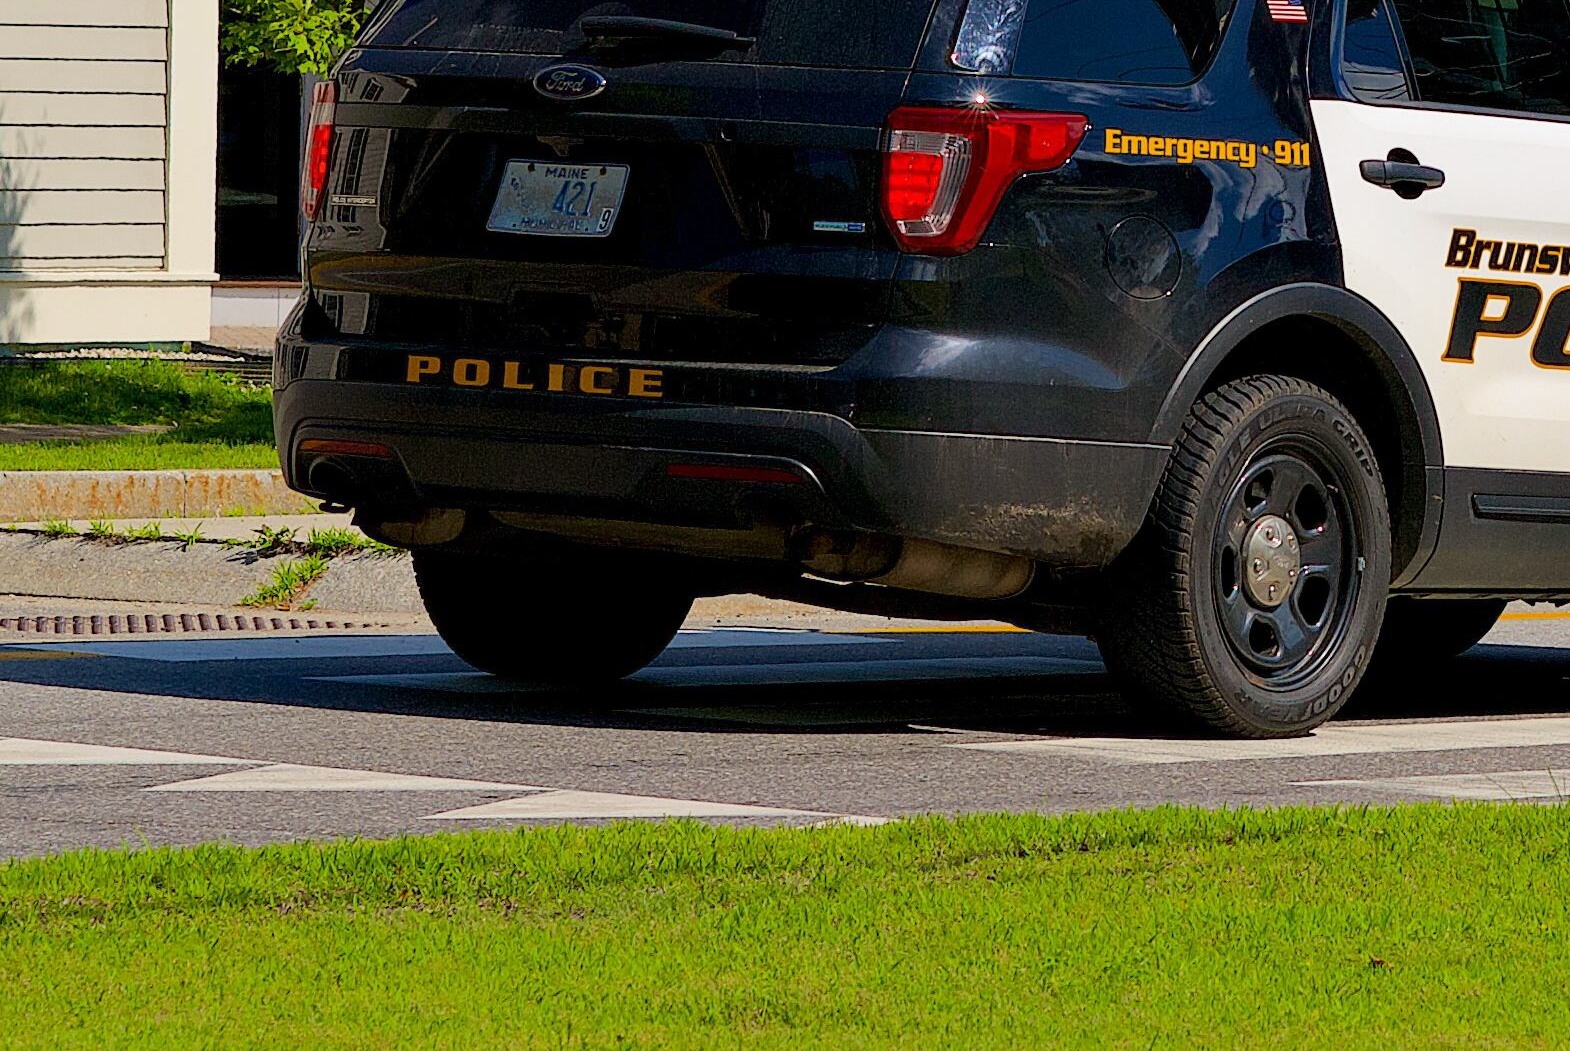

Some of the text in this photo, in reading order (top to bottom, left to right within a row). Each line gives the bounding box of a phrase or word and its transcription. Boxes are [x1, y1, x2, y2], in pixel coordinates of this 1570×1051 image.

[545, 70, 587, 92] Ford
[1104, 127, 1310, 169] Emergency 911
[545, 167, 590, 180] MAINE
[553, 180, 597, 216] 421
[406, 354, 664, 398] POLICE
